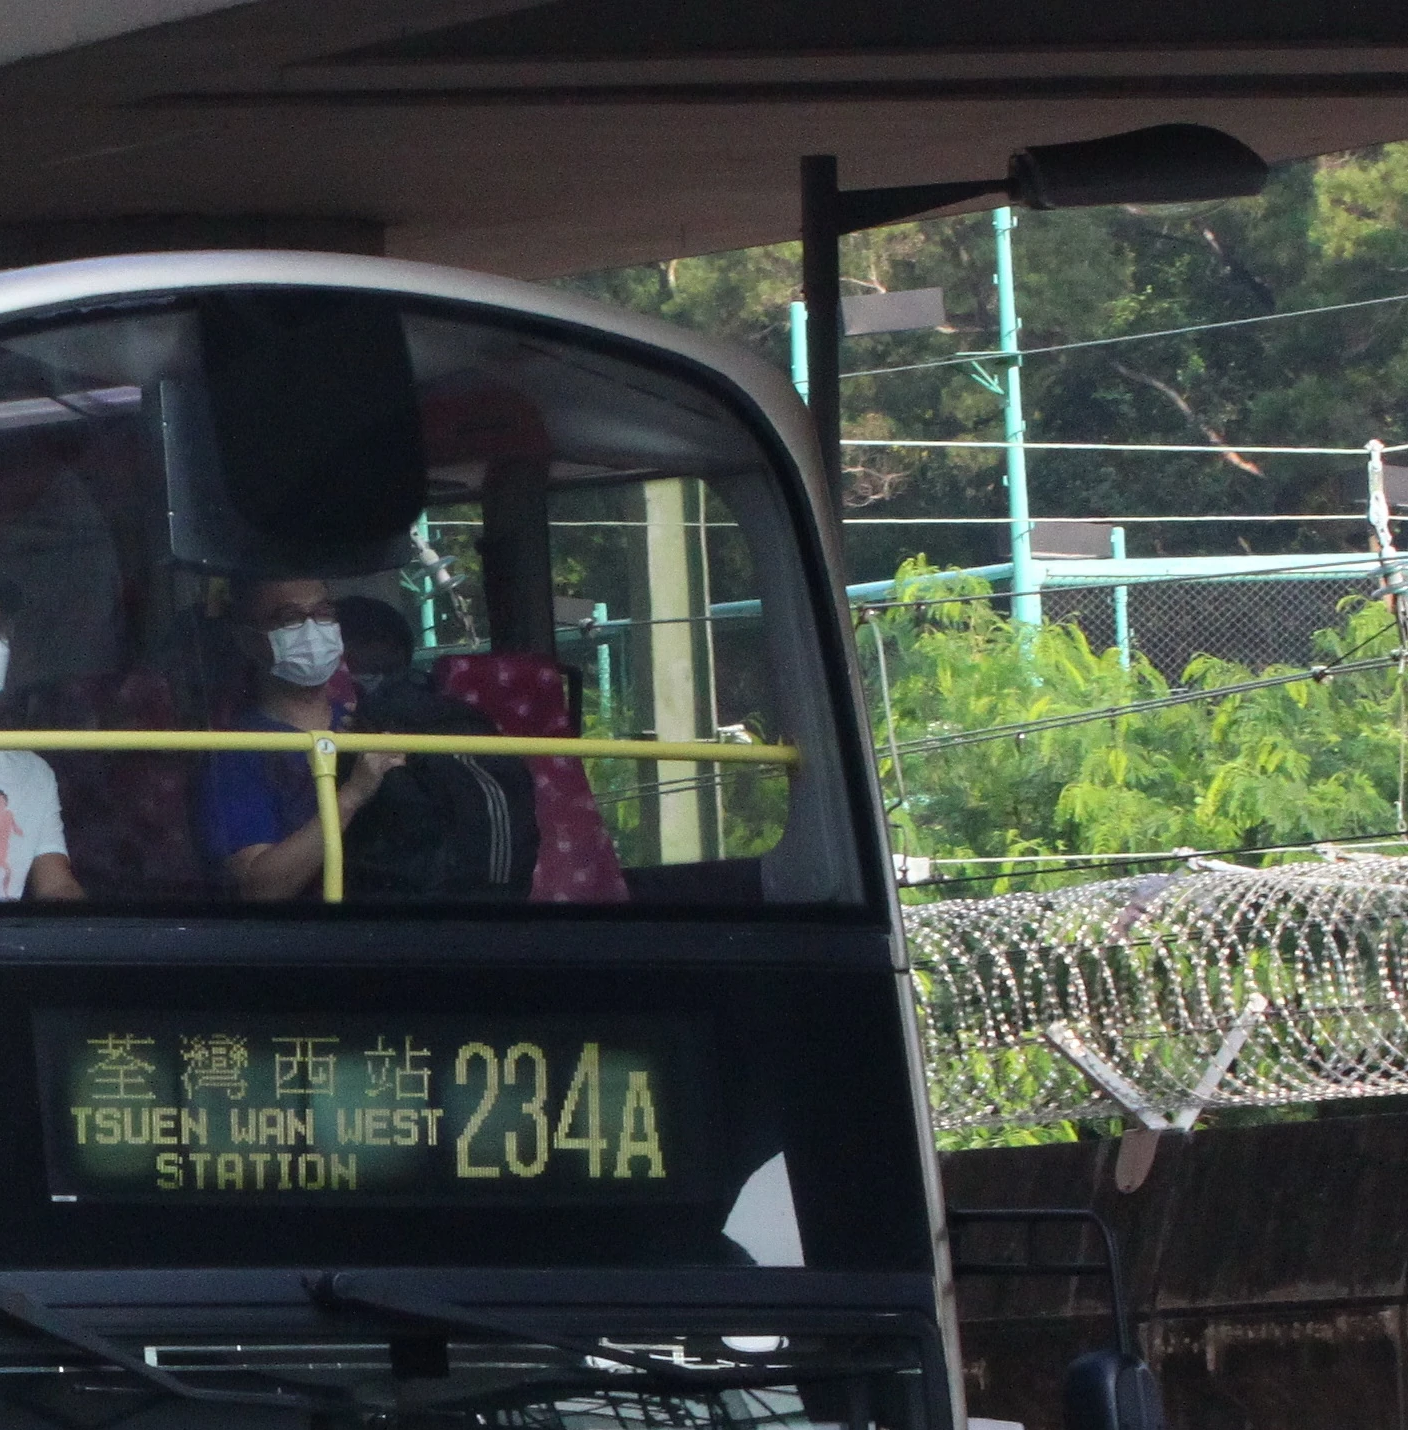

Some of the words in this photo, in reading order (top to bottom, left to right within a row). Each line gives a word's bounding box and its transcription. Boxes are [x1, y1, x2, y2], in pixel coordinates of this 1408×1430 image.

[86, 1032, 433, 1101] 荃灣西站
[69, 1106, 210, 1147] TSUEN
[230, 1107, 316, 1147] WAN
[336, 1108, 444, 1147] WEST
[454, 1041, 667, 1178] 234A
[155, 1152, 358, 1191] STATION
